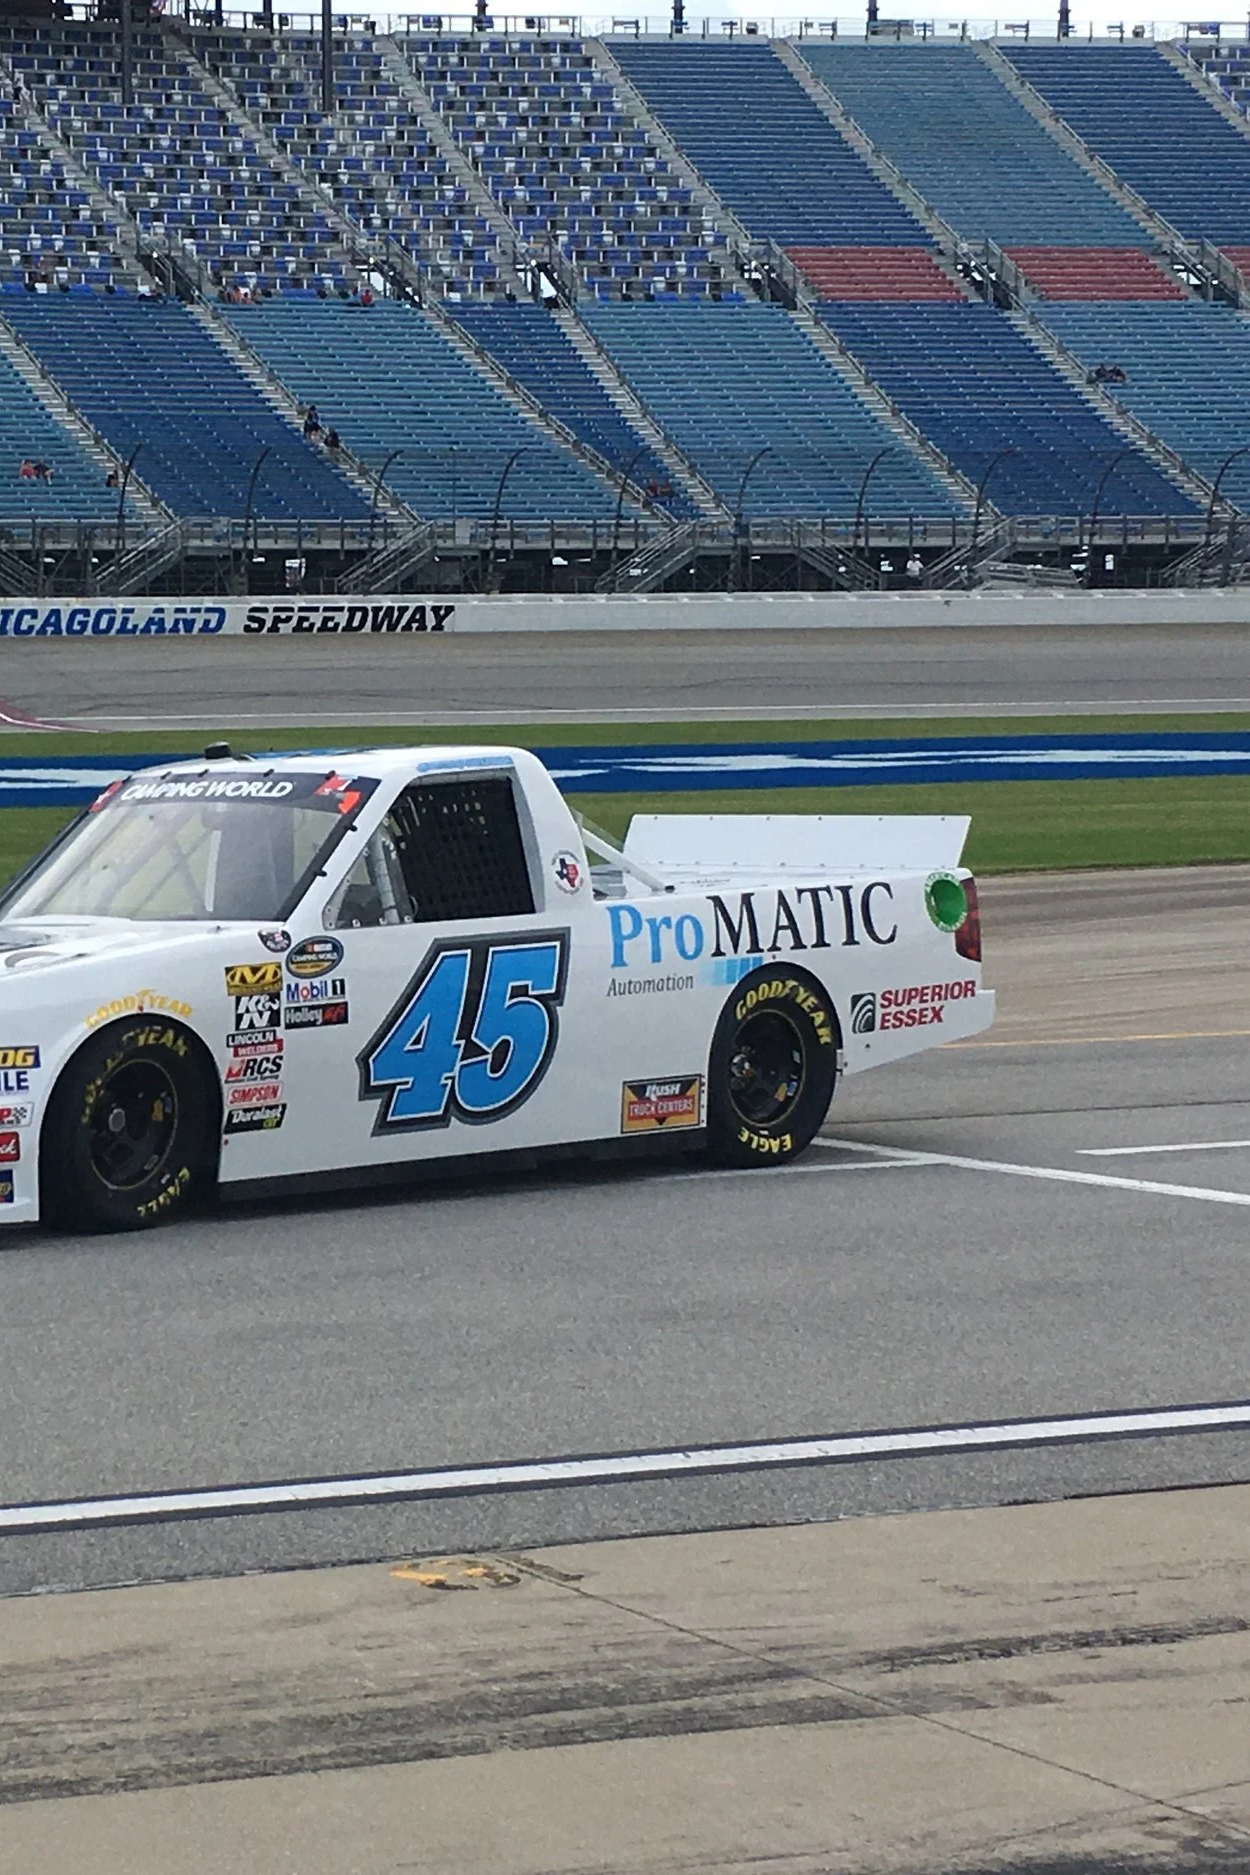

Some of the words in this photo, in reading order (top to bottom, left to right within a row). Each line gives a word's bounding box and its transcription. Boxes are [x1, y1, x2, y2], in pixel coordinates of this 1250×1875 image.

[243, 604, 456, 634] SPEEDWAY
[121, 784, 207, 800] CAMPING
[205, 781, 294, 798] WORLD
[286, 981, 328, 1000] Mobil
[607, 974, 694, 997] Automation
[880, 980, 976, 1009] SUPERIOR
[84, 988, 192, 1027] GOODYEAR
[285, 1007, 322, 1025] Holley
[735, 979, 833, 1046] GOODYEAR
[880, 1005, 944, 1030] ESSEX
[229, 1030, 275, 1046] LINCOLN
[360, 930, 568, 1132] 45
[242, 1055, 284, 1077] RCS
[230, 1085, 280, 1104] SIMPSON
[231, 1105, 282, 1123] Duralast
[737, 1126, 793, 1153] EAGLE
